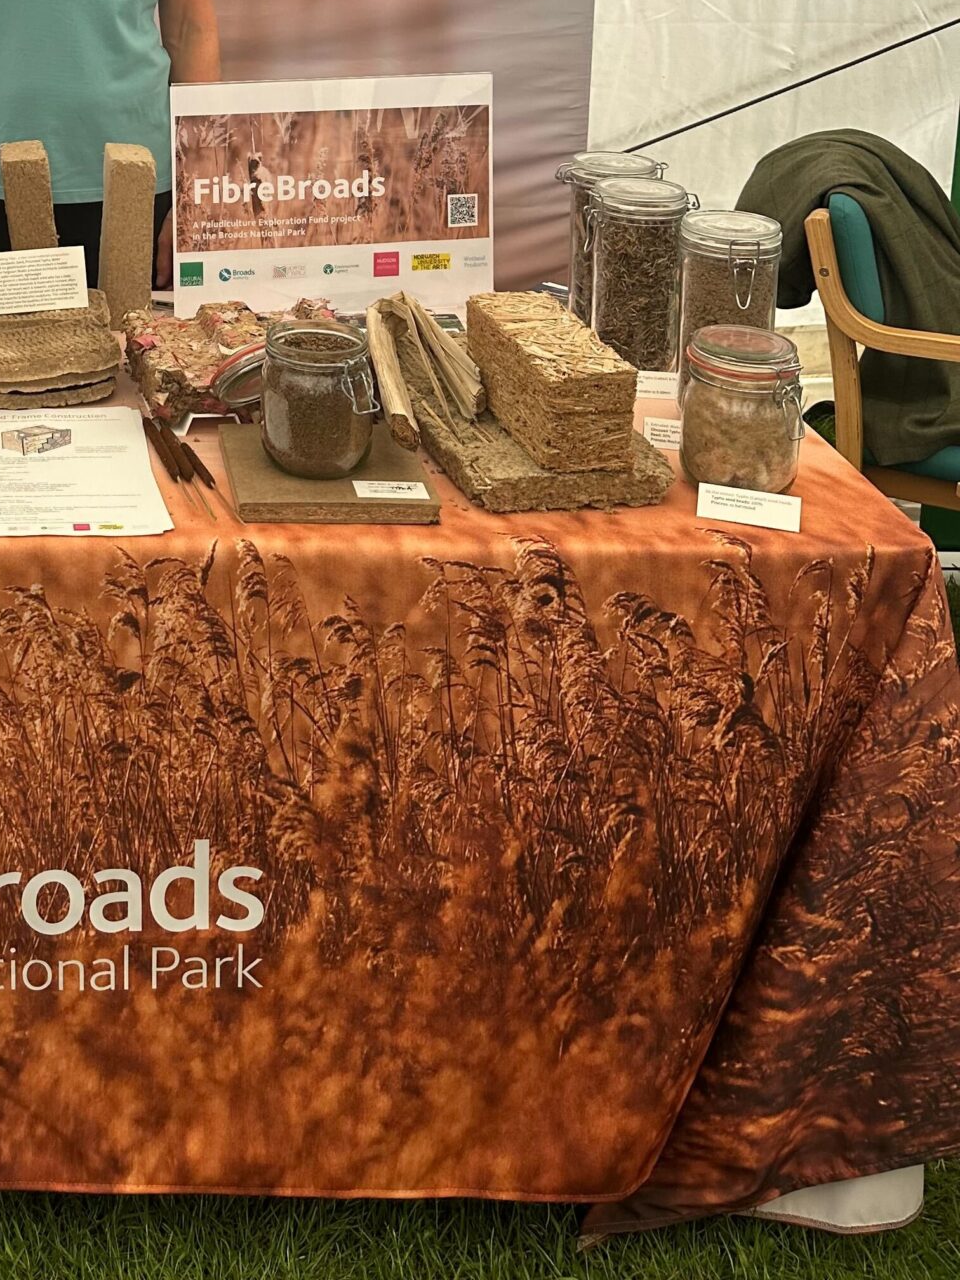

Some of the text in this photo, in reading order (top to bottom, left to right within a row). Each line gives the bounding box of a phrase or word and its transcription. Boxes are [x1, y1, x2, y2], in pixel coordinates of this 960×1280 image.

[193, 170, 386, 205] FibreBroads
[193, 214, 362, 229] A Paludiculture Exploration Fund project
[193, 228, 306, 240] in the Broads National Park
[232, 268, 256, 276] Broads
[151, 943, 263, 990] Park
